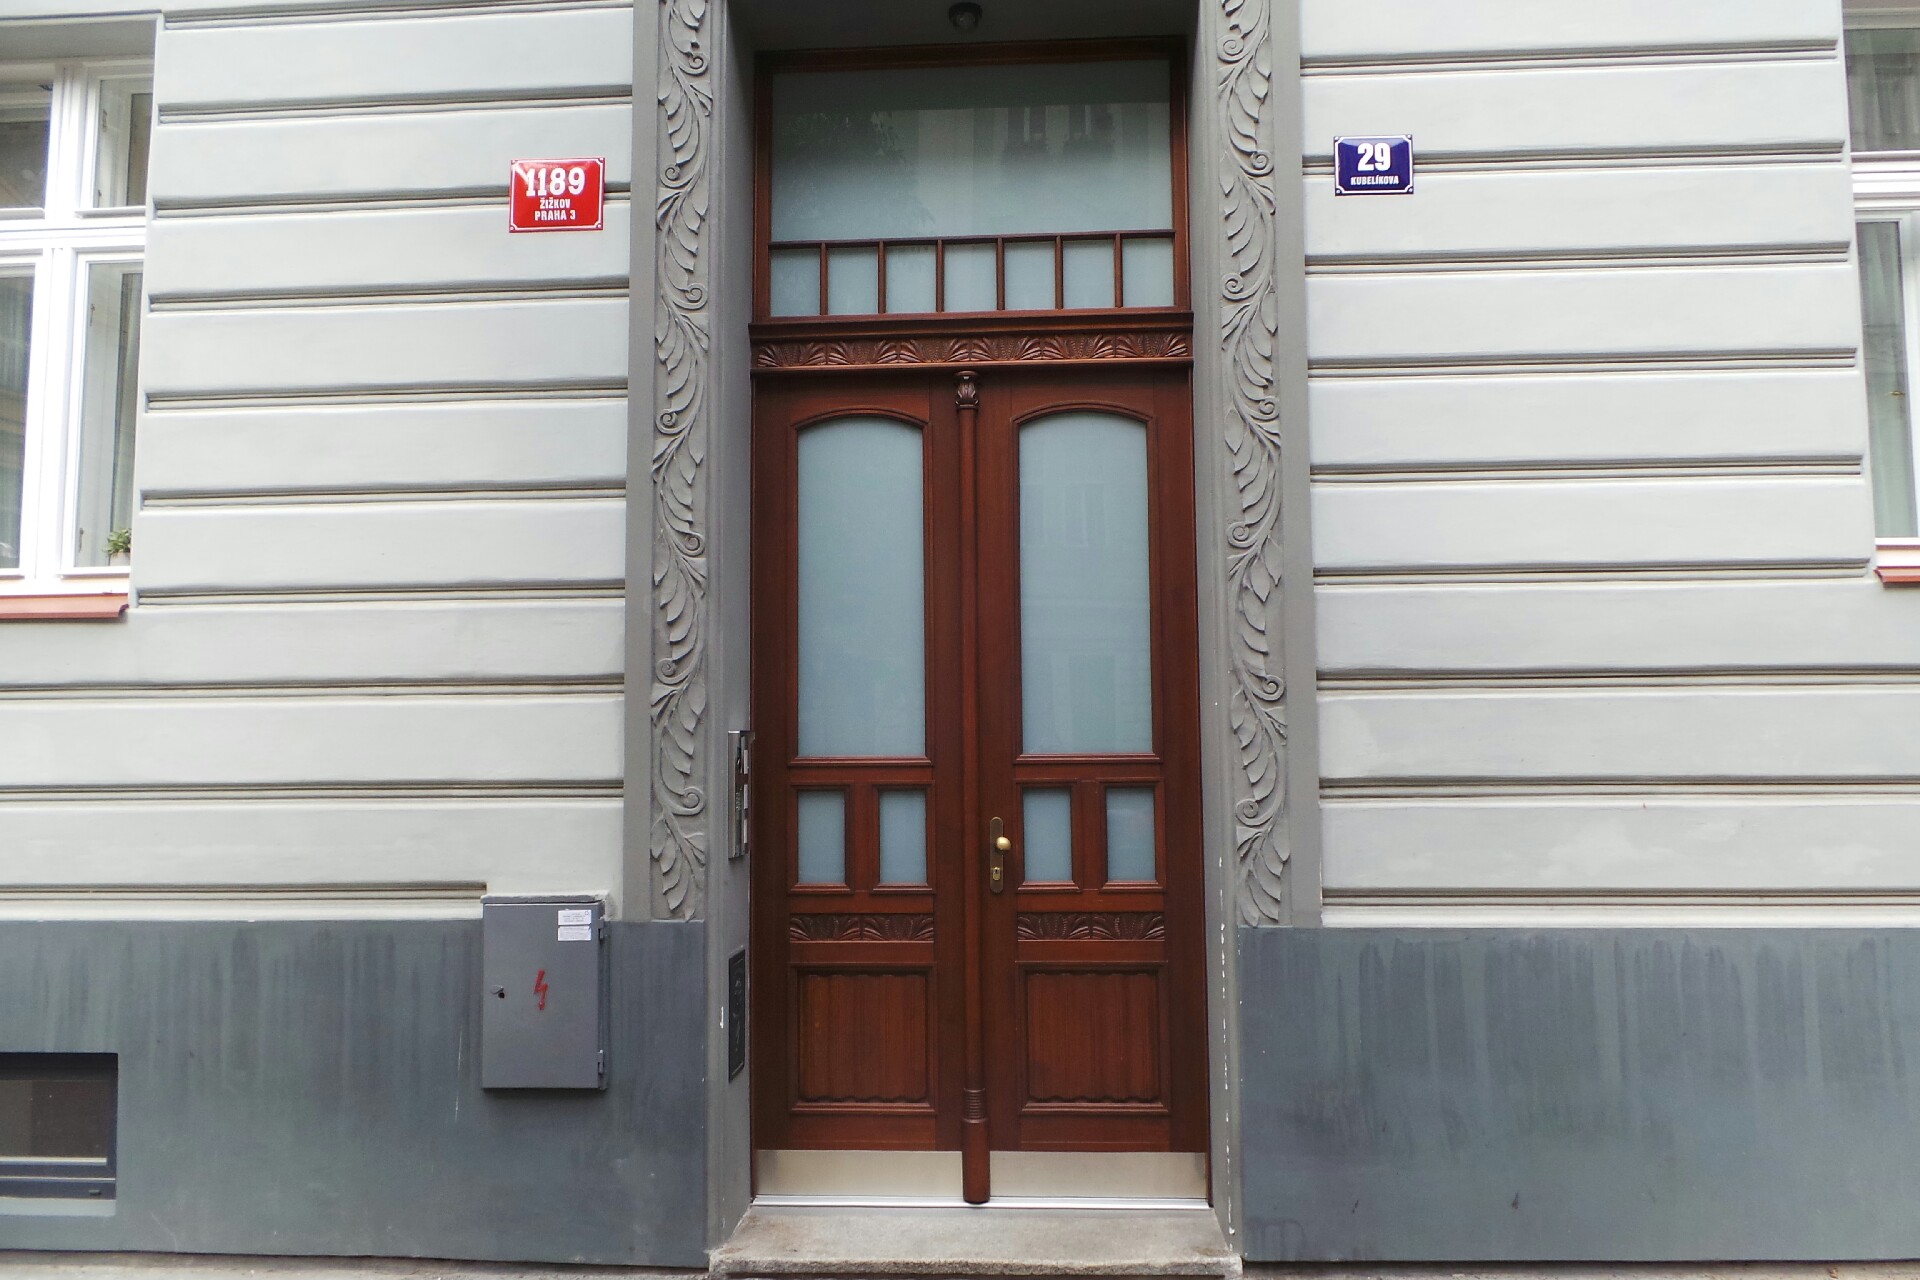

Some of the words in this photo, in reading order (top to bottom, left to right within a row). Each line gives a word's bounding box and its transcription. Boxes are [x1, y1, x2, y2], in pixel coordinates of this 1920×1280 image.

[1357, 142, 1391, 171] 29
[526, 167, 586, 197] 1189
[1350, 174, 1399, 186] KUBELÍKOVA
[539, 196, 571, 209] ŽIŽKOV
[534, 210, 567, 221] PRAHA
[569, 209, 576, 220] 3
